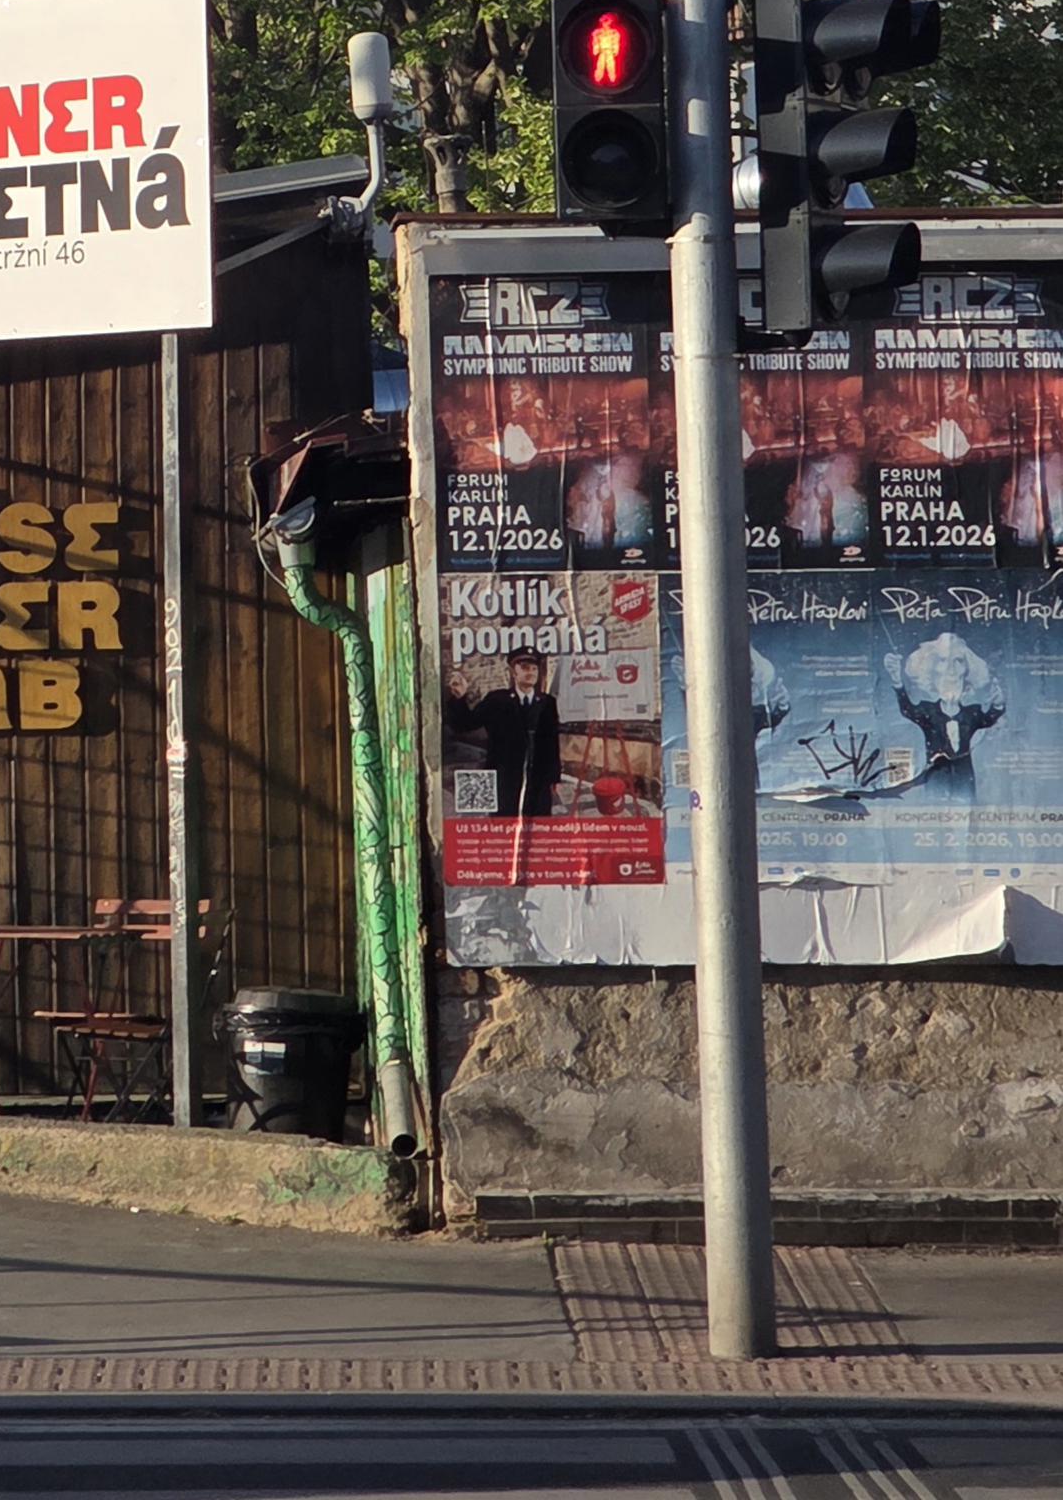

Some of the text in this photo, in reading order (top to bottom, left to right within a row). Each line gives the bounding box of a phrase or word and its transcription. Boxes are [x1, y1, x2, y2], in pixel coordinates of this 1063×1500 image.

[55, 240, 85, 265] 46
[530, 356, 586, 374] TRIBUTE
[589, 355, 633, 373] SHOW
[748, 353, 851, 370] TRIBUTE SHOW
[875, 352, 960, 370] SYMPHONIC
[963, 351, 1020, 369] TRIBUTE
[447, 473, 509, 488] FORUM
[880, 468, 941, 482] FORUM
[880, 483, 942, 498] KARLÍN
[447, 505, 532, 526] PRAHA
[880, 501, 965, 521] PRAHA
[448, 528, 564, 551] 12.1.2026
[881, 525, 997, 547] 12.1.2026
[450, 579, 567, 617] Kotlík
[880, 587, 947, 623] Pocta
[947, 587, 1013, 623] Petru
[450, 617, 609, 668] pomáhá
